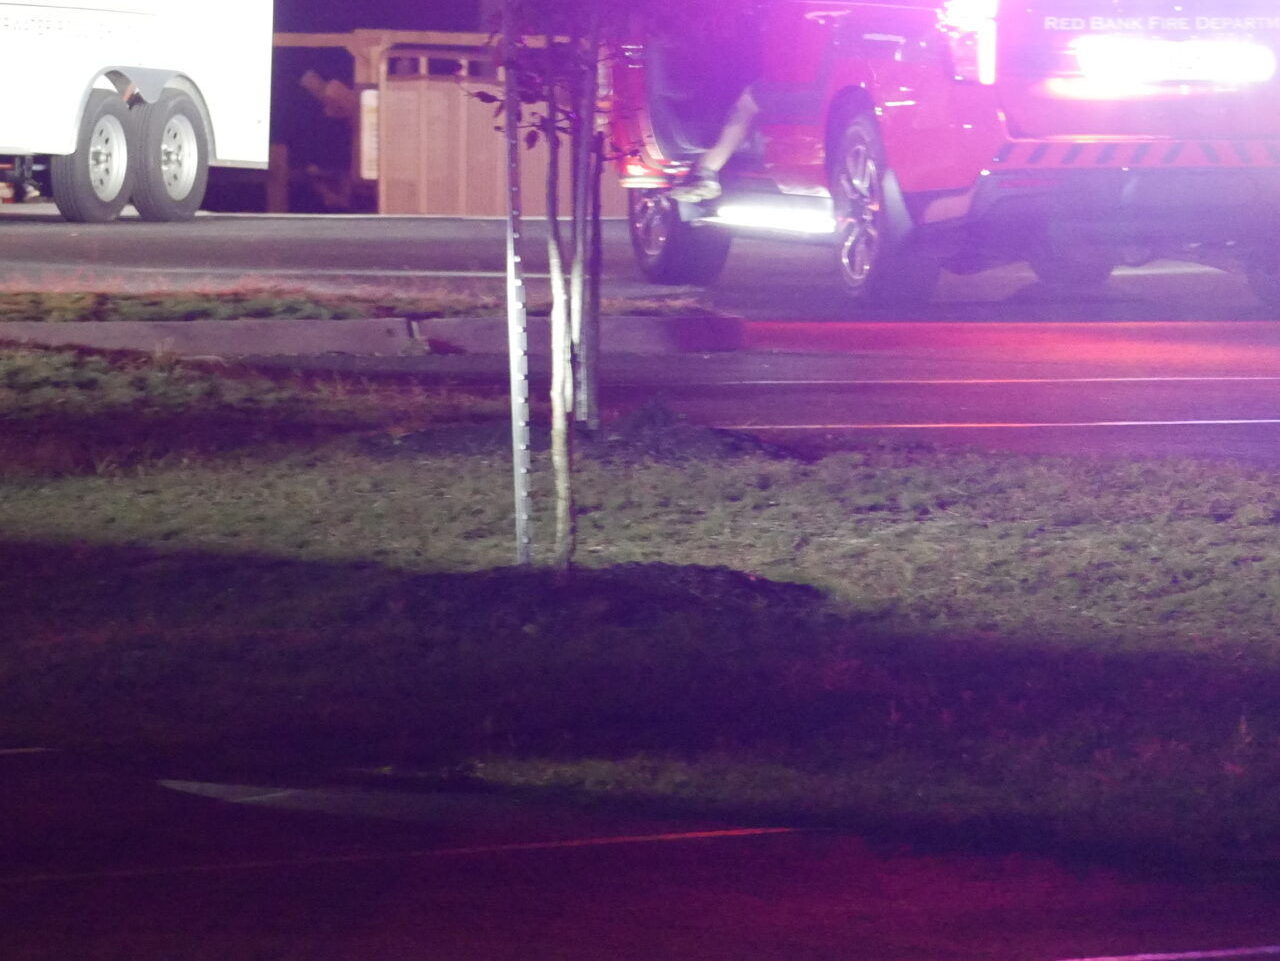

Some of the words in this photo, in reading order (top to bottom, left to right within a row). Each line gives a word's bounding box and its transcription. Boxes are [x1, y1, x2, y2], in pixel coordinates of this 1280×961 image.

[1044, 16, 1085, 31] RED
[1089, 16, 1144, 31] BANK
[1148, 16, 1191, 31] FIRE
